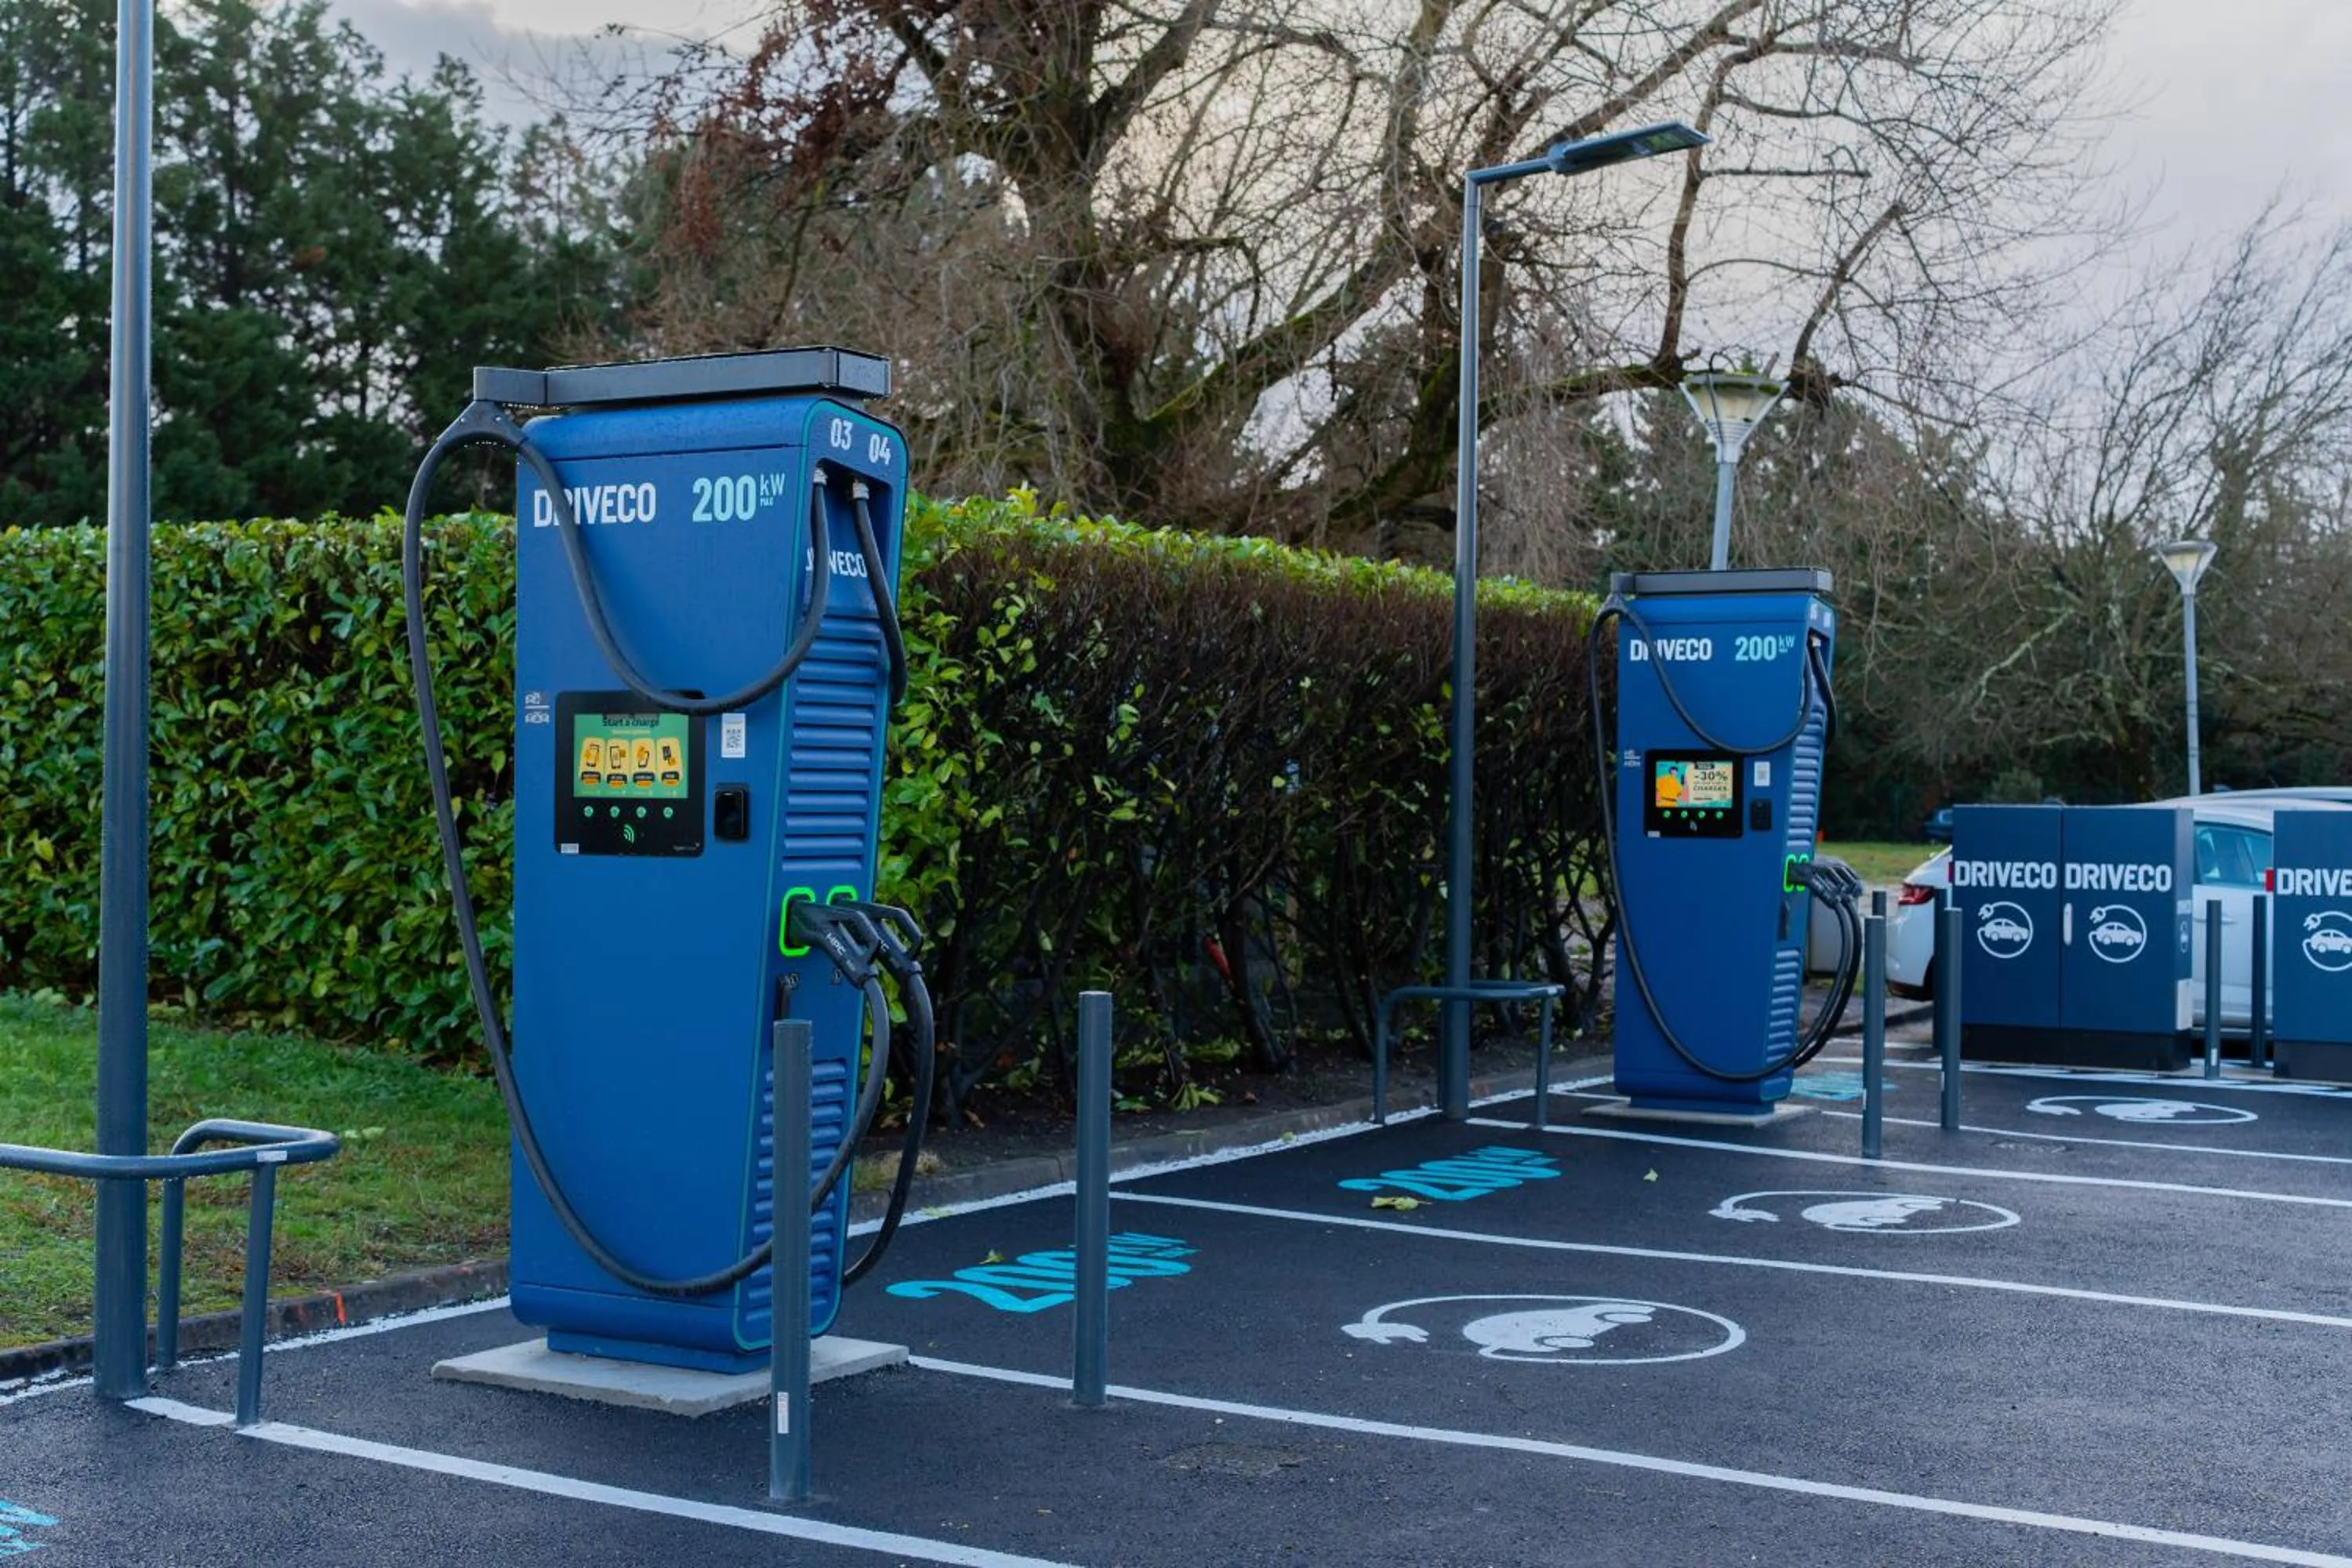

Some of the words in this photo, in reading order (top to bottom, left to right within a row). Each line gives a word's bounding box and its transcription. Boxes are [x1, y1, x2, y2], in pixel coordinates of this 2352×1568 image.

[831, 419, 853, 451] 03
[869, 433, 891, 465] 04
[534, 482, 656, 528] DIVECO
[692, 474, 757, 522] 200
[760, 473, 786, 495] kW
[1734, 635, 1777, 661] 200
[1954, 860, 2057, 889] DRIVECO
[2064, 862, 2172, 892] DRIVECO
[1338, 1160, 1561, 1202] 200
[884, 1249, 1192, 1314] 200
